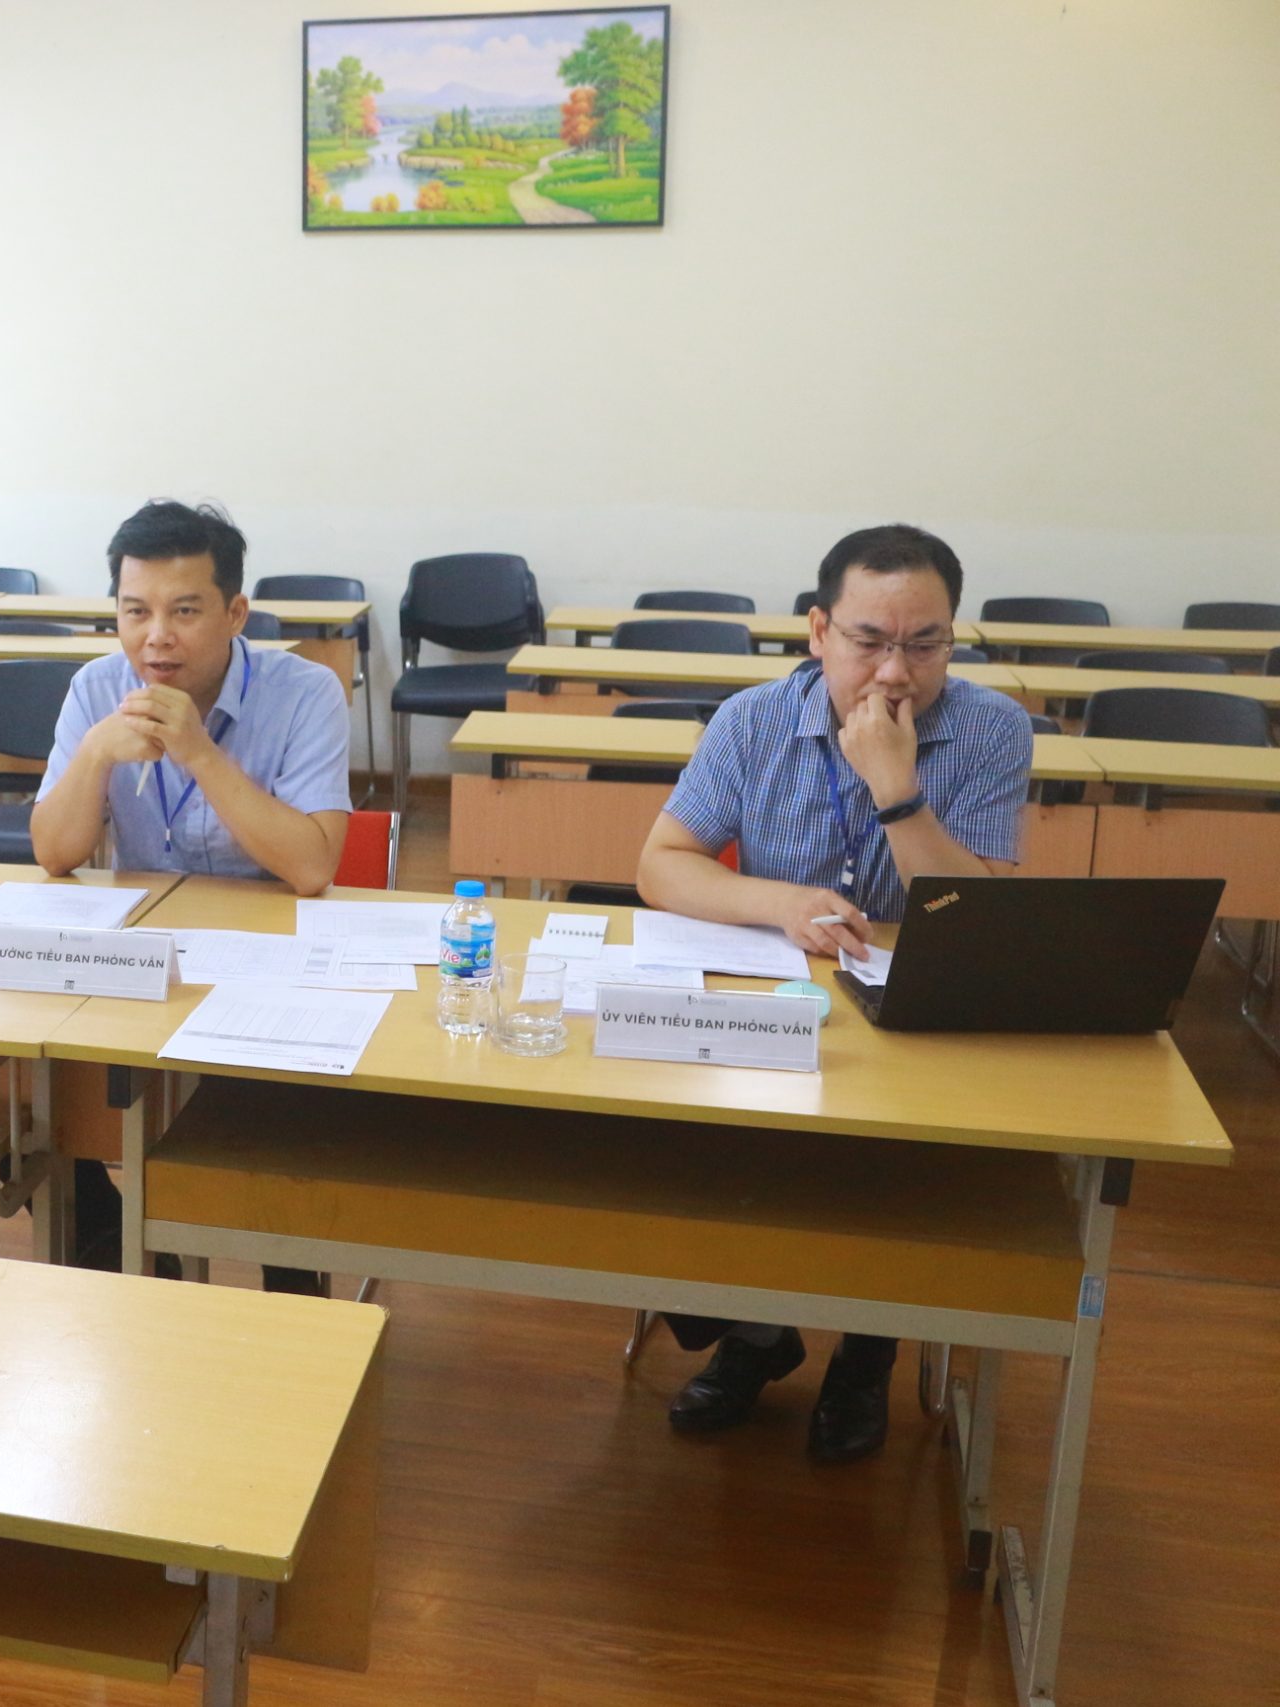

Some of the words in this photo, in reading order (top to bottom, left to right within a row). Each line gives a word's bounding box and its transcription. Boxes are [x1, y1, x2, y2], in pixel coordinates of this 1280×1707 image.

[923, 890, 960, 913] ThinkPad
[65, 953, 90, 964] BAN
[624, 1012, 657, 1025] VIÊN
[694, 1018, 724, 1030] BAN
